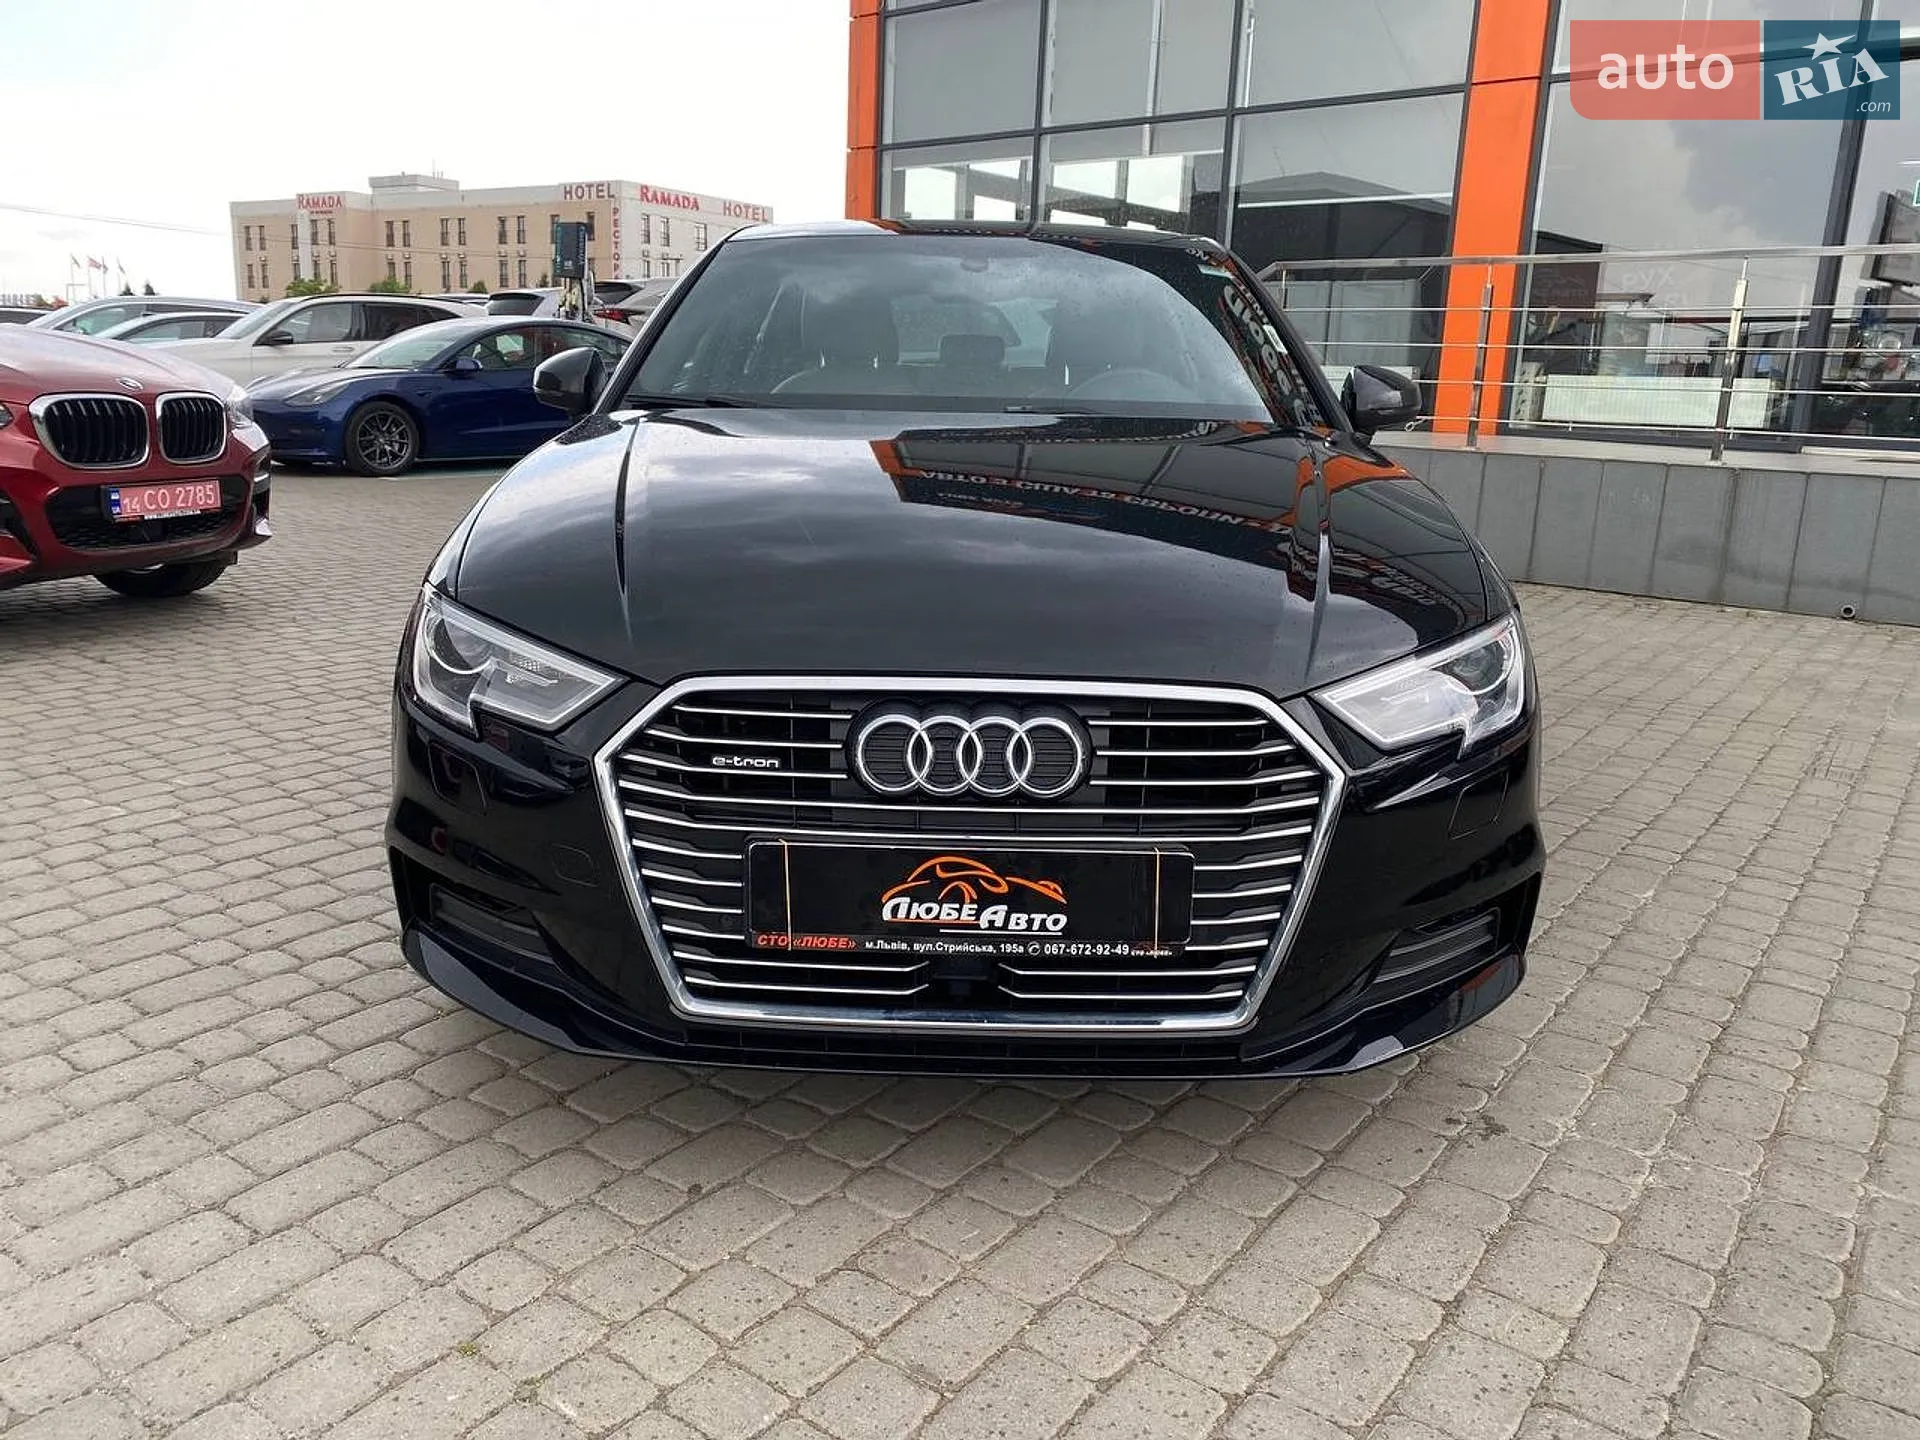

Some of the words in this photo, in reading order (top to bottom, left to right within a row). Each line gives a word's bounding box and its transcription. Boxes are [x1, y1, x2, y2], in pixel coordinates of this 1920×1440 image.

[563, 183, 615, 200] HOTEL
[298, 194, 342, 209] RAMADA
[640, 185, 700, 211] RAMADA
[723, 200, 769, 222] HOTEL
[123, 497, 140, 513] 14
[176, 484, 215, 507] 2785
[712, 755, 779, 768] e-tron
[757, 934, 788, 947] СТО
[1044, 943, 1130, 956] 067-672-92-49
